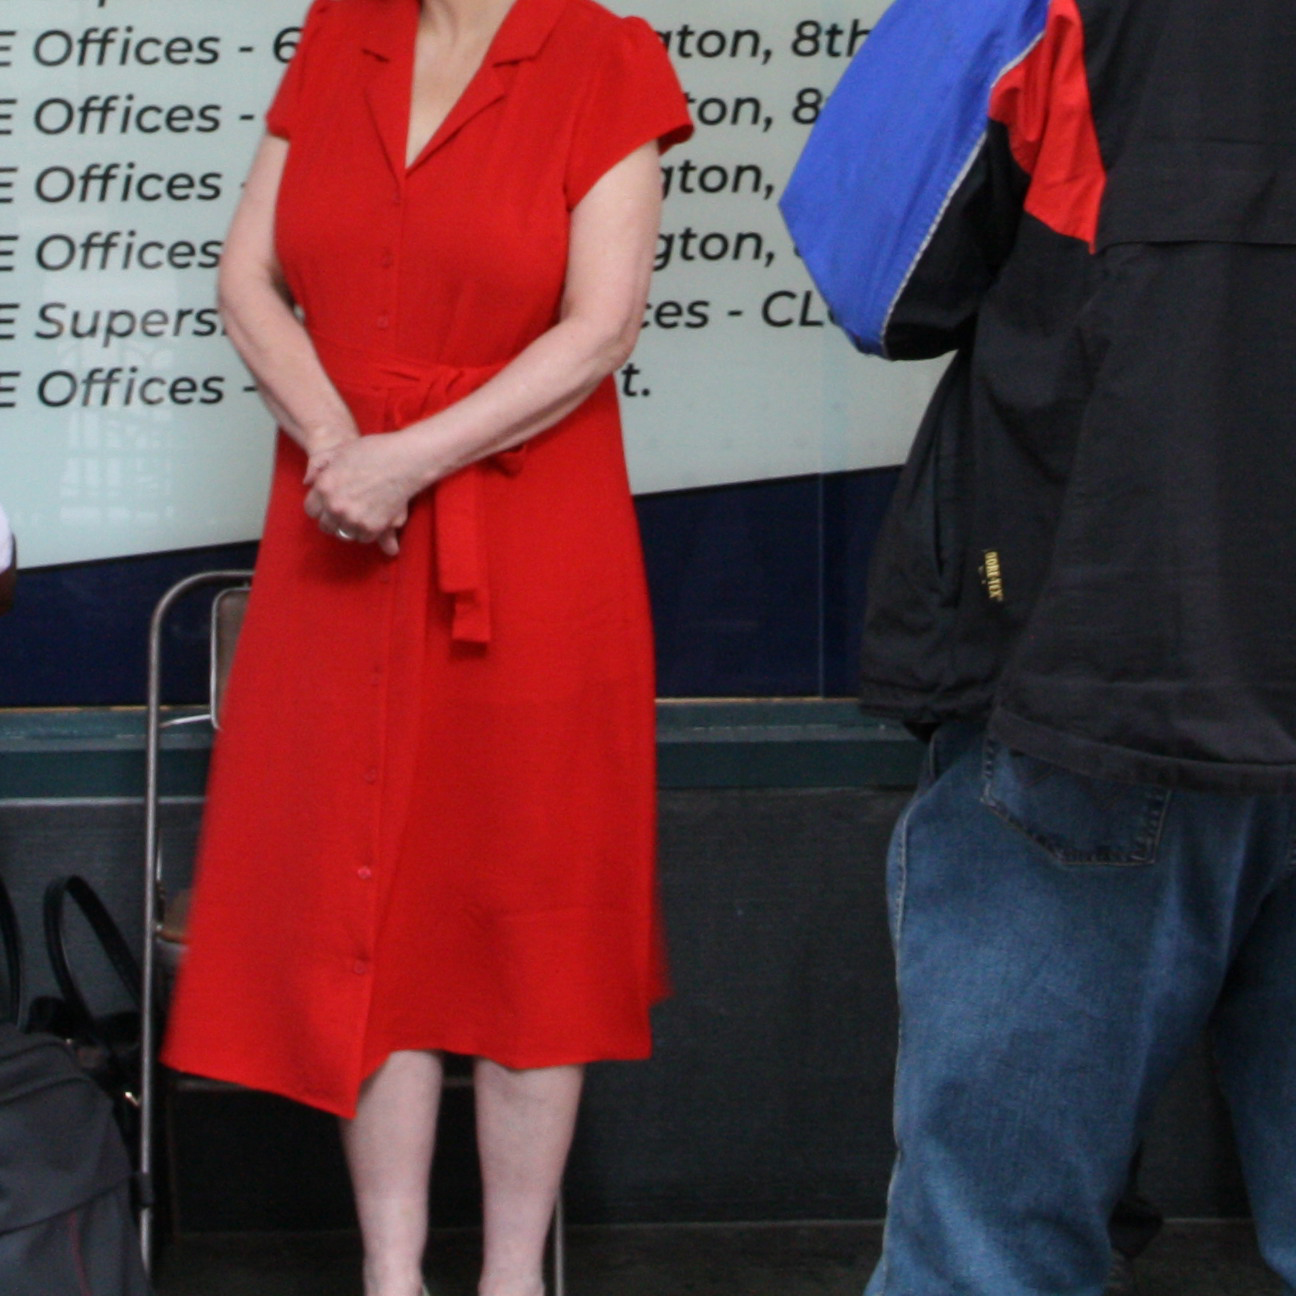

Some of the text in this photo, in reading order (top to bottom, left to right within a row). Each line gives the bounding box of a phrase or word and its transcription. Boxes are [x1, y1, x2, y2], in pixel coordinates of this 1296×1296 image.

[33, 25, 221, 67] Offices
[33, 93, 222, 135] Offices
[34, 161, 223, 204] Offices
[35, 230, 225, 271] Offices
[34, 302, 228, 350] Supers
[37, 366, 225, 408] Offices
[621, 363, 651, 398] t.
